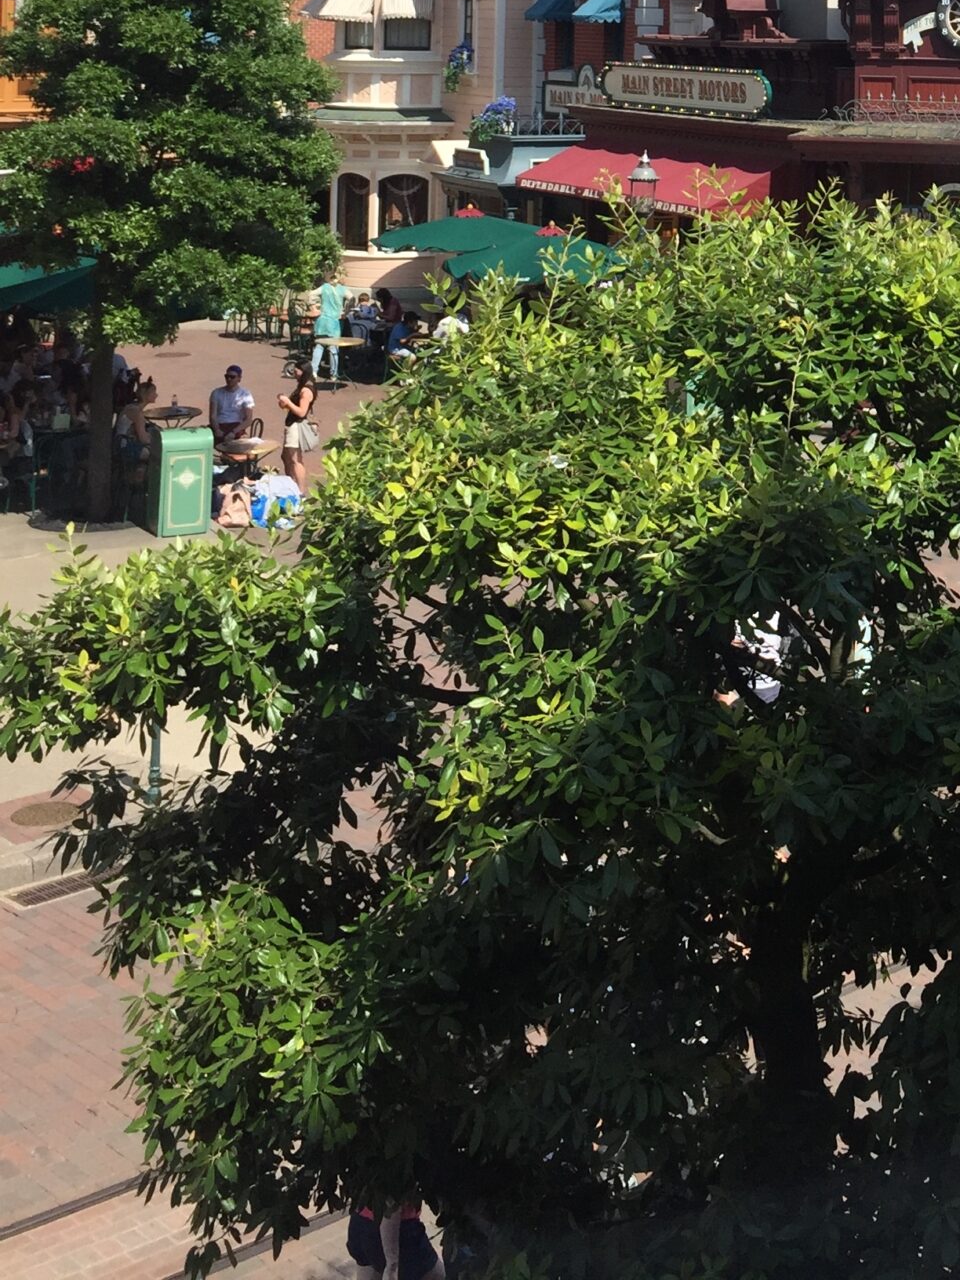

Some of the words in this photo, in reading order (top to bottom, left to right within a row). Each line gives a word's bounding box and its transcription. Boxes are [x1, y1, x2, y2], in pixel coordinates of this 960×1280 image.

[550, 89, 573, 104] MAIN
[622, 74, 650, 96] MAIN
[653, 76, 694, 100] STREET
[699, 80, 747, 104] MOTORS
[520, 178, 577, 196] DEPENDABLE
[582, 187, 600, 199] ALL
